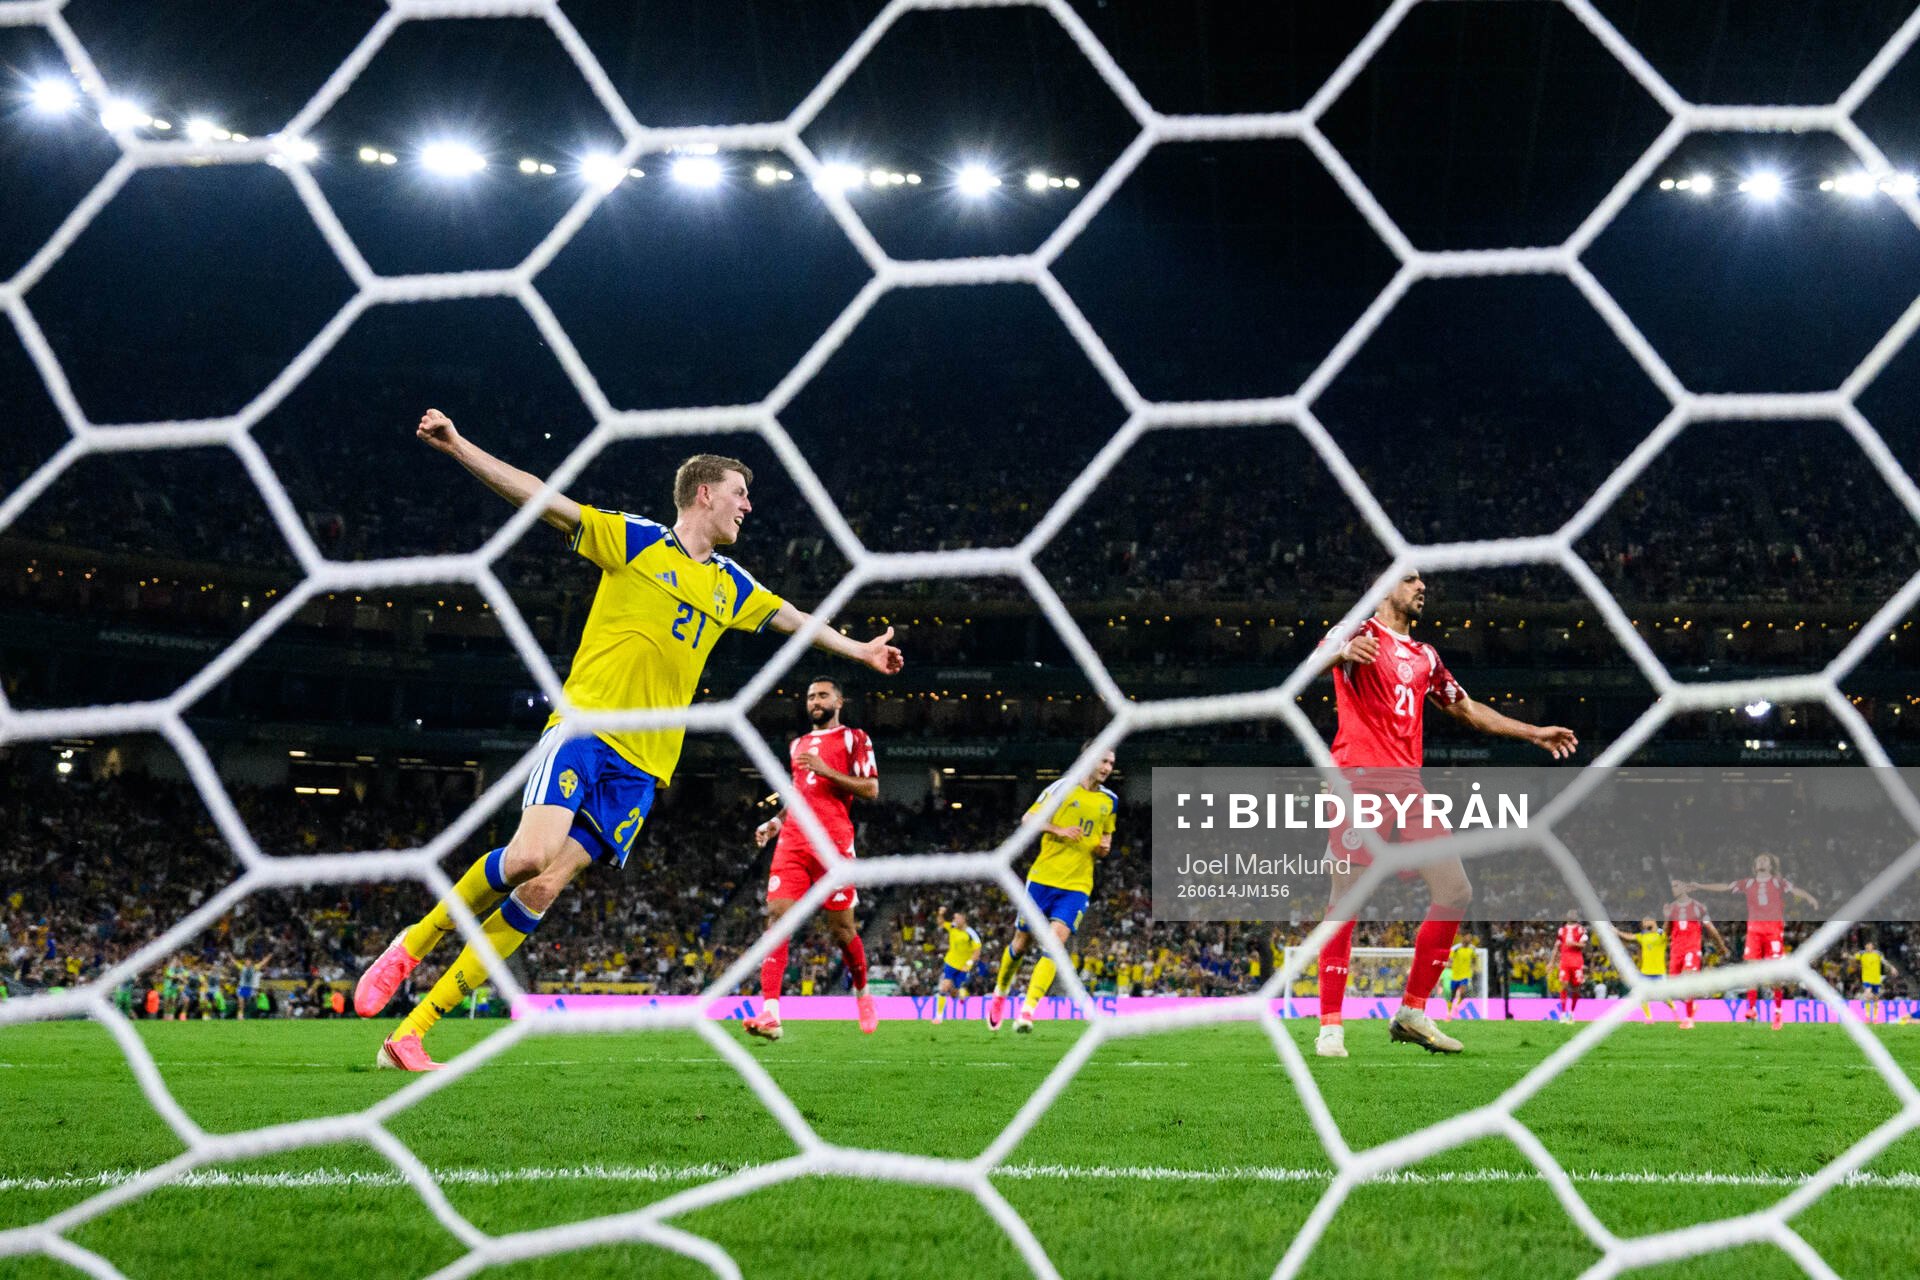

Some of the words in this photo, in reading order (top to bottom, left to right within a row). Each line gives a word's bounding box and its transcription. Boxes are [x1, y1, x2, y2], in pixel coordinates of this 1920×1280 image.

[672, 602, 707, 649] 21
[1394, 684, 1415, 717] 21
[614, 807, 644, 851] 21
